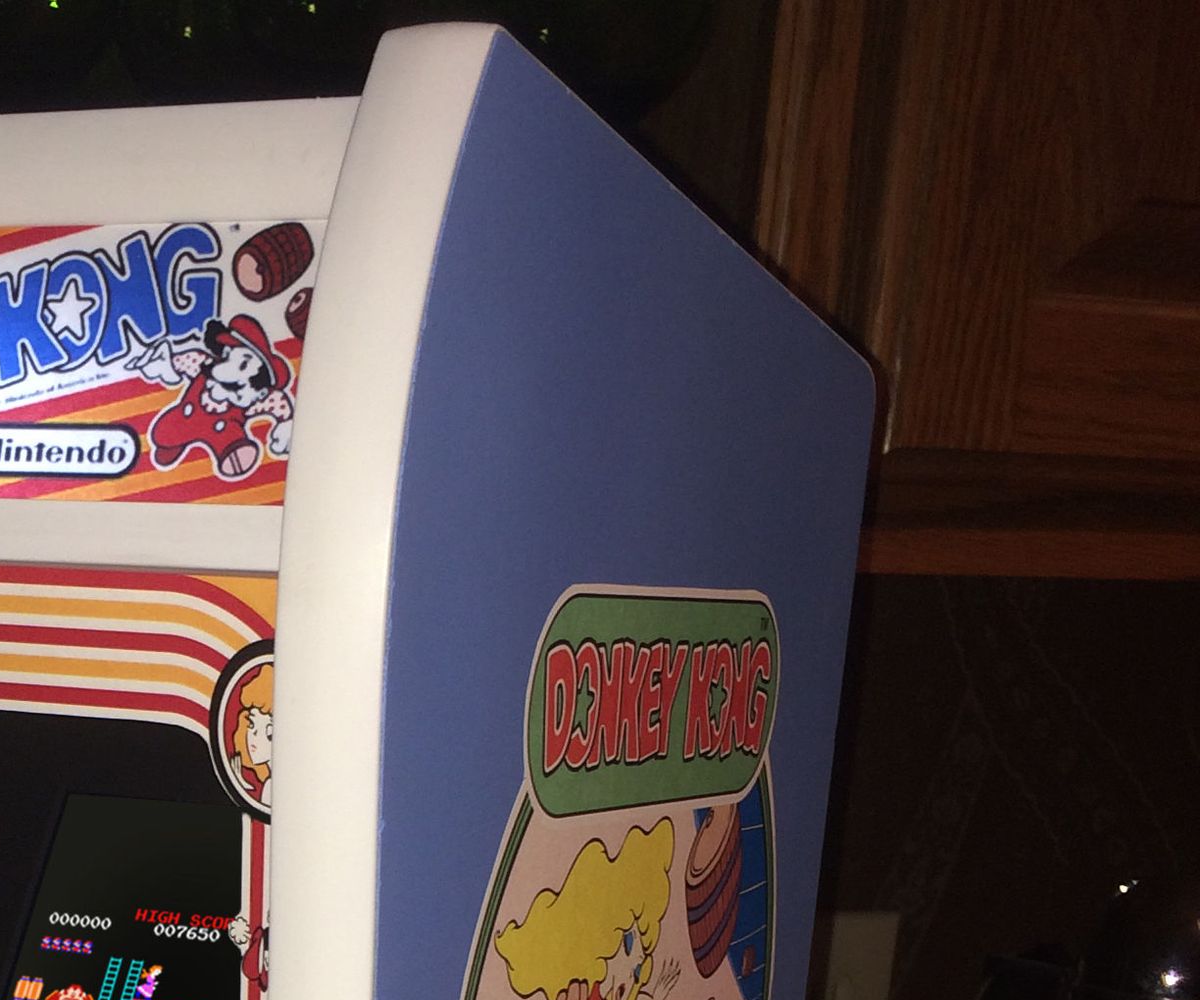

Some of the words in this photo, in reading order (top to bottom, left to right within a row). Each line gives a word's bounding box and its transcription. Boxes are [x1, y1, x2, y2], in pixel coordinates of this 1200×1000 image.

[543, 637, 689, 777] DONKEY
[683, 637, 772, 762] KONG
[49, 911, 112, 930] 000000
[135, 908, 181, 925] HIGH
[189, 914, 235, 930] SCOR
[153, 923, 221, 942] 007650
